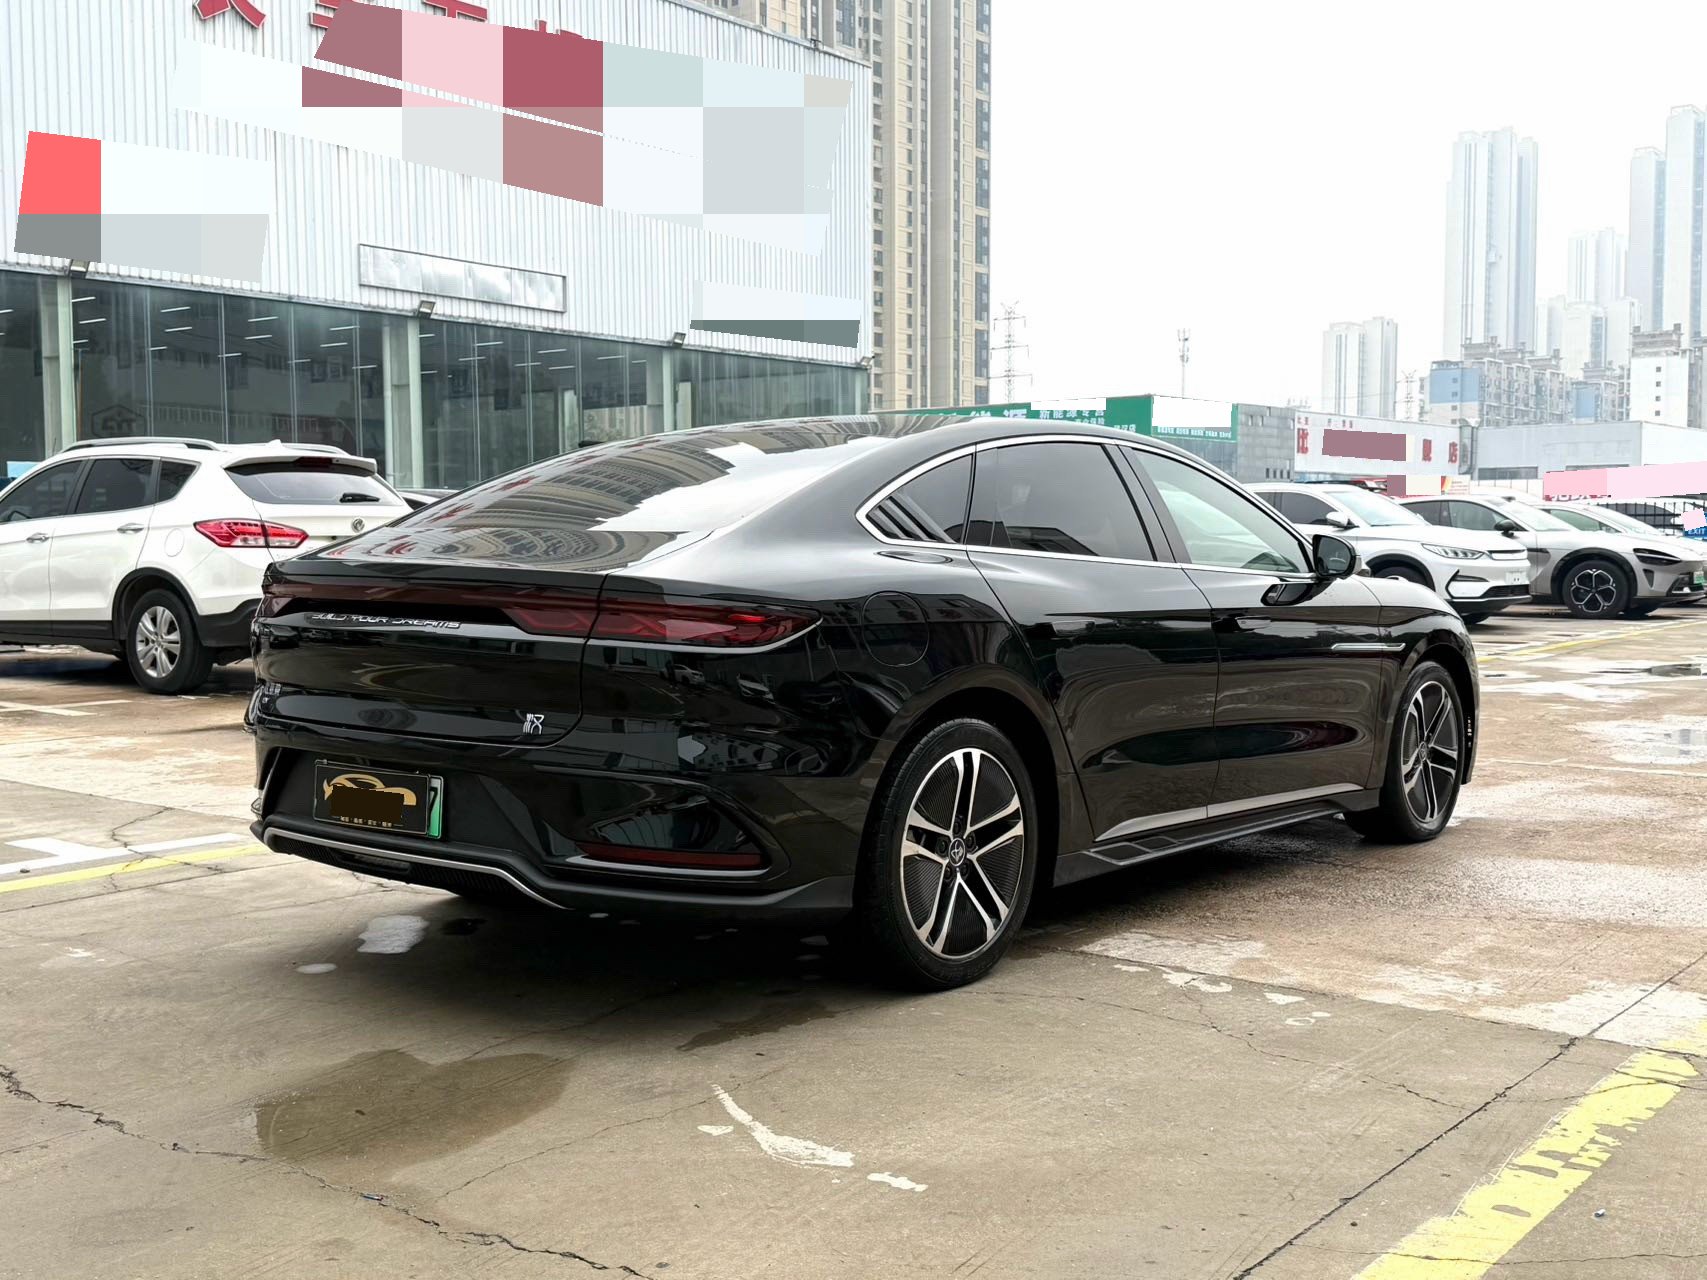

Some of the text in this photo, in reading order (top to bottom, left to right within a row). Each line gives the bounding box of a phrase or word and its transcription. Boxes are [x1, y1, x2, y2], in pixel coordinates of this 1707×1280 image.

[1688, 527, 1706, 535] EXIT
[312, 613, 461, 629] BUILD YOUR DREAMS
